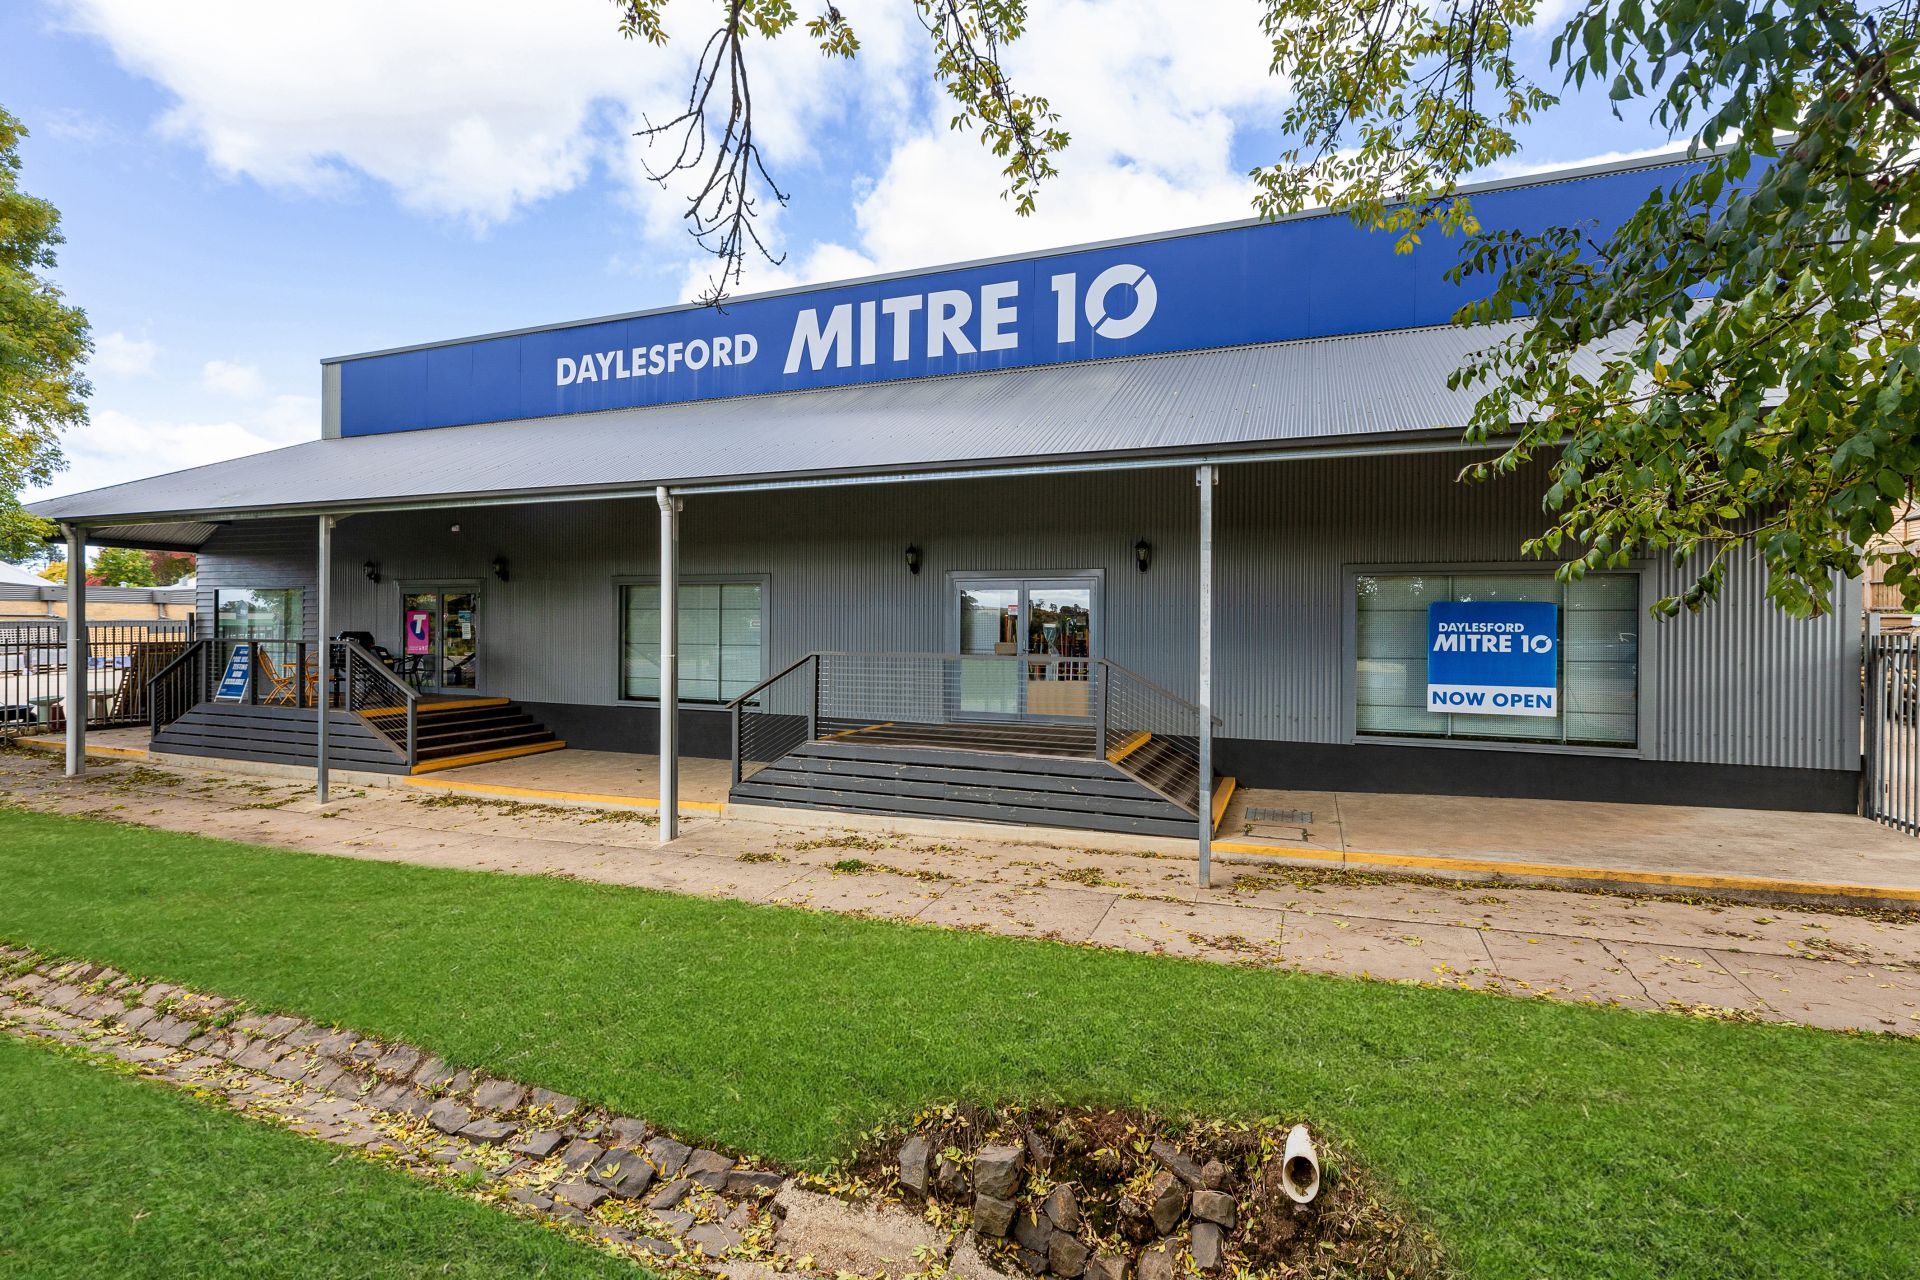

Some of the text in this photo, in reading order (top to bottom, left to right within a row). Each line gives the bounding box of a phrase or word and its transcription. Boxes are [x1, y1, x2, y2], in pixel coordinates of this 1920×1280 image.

[556, 263, 1158, 386] DAYLESFORD MITRE 10
[1438, 622, 1525, 633] DAYLESFORD
[1433, 634, 1553, 654] MITRE 10
[1432, 691, 1552, 709] NOW OPEN
